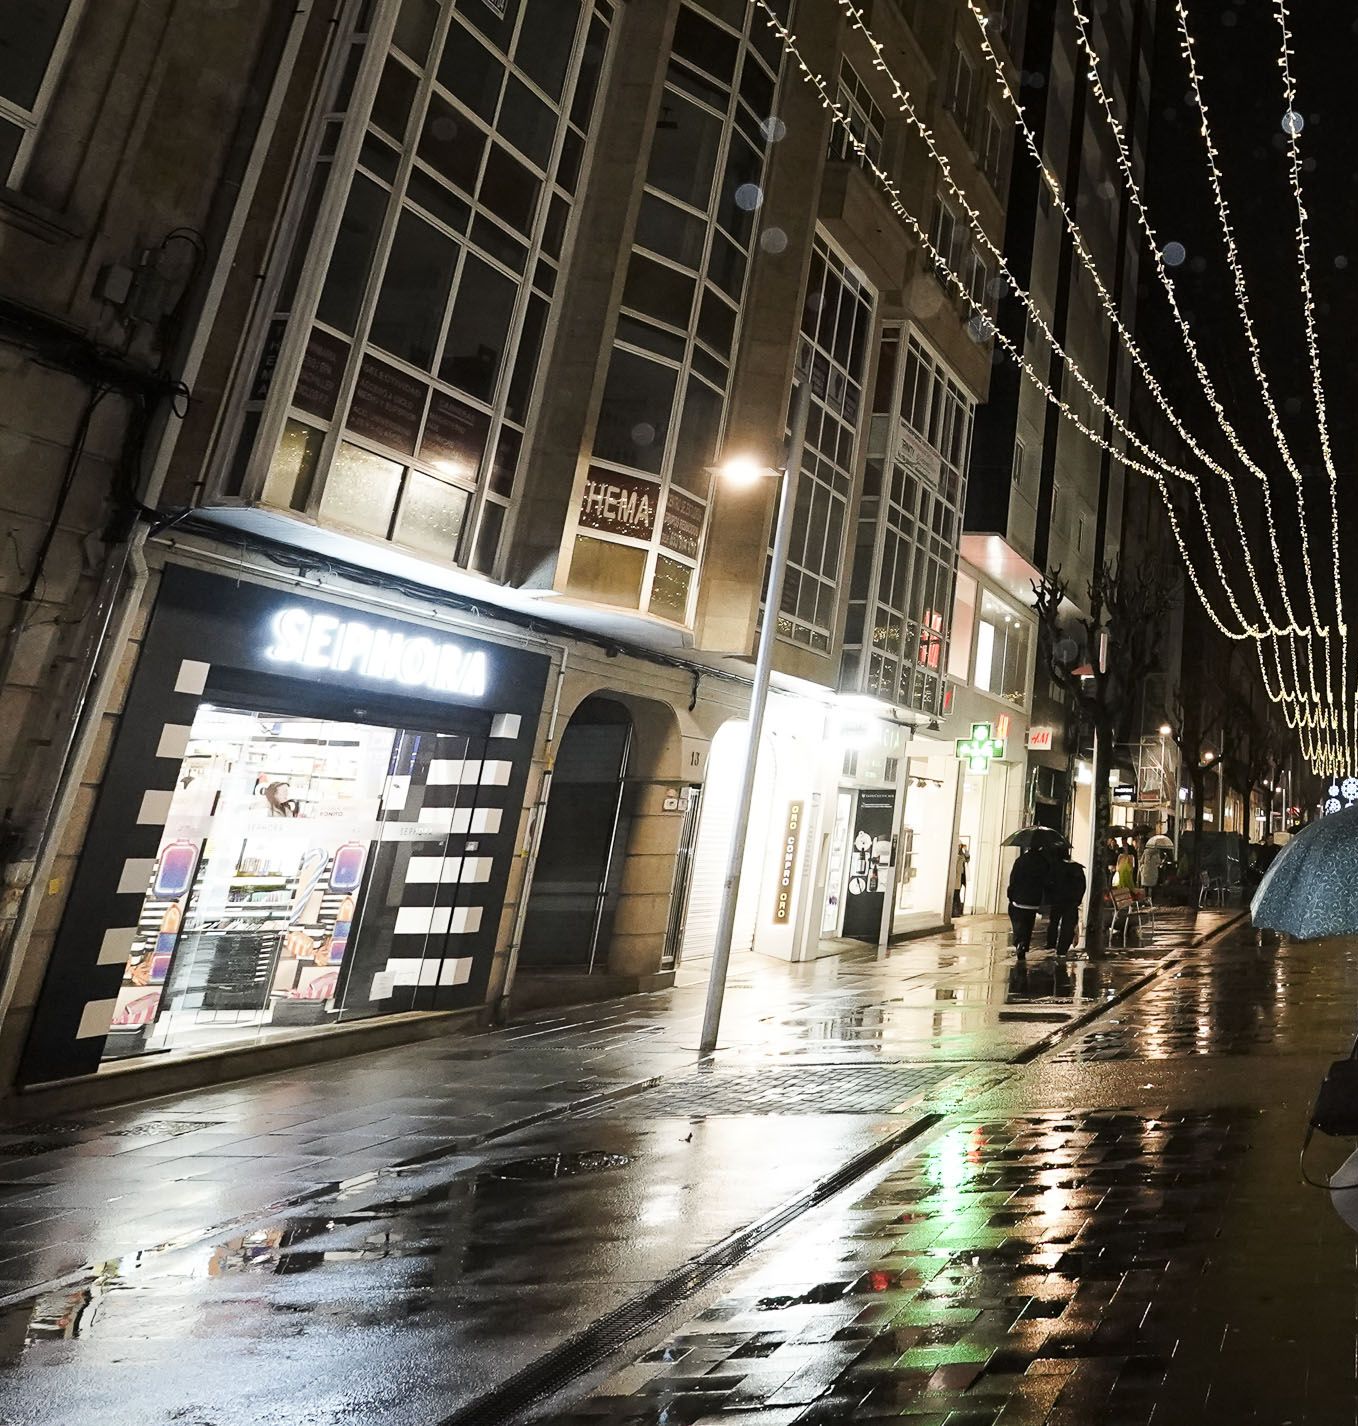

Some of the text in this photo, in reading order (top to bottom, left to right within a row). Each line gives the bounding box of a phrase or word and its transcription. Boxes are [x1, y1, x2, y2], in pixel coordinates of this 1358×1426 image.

[265, 608, 486, 696] SEPHORA
[690, 751, 701, 766] 13
[777, 805, 799, 918] ORO COMPRO ORO
